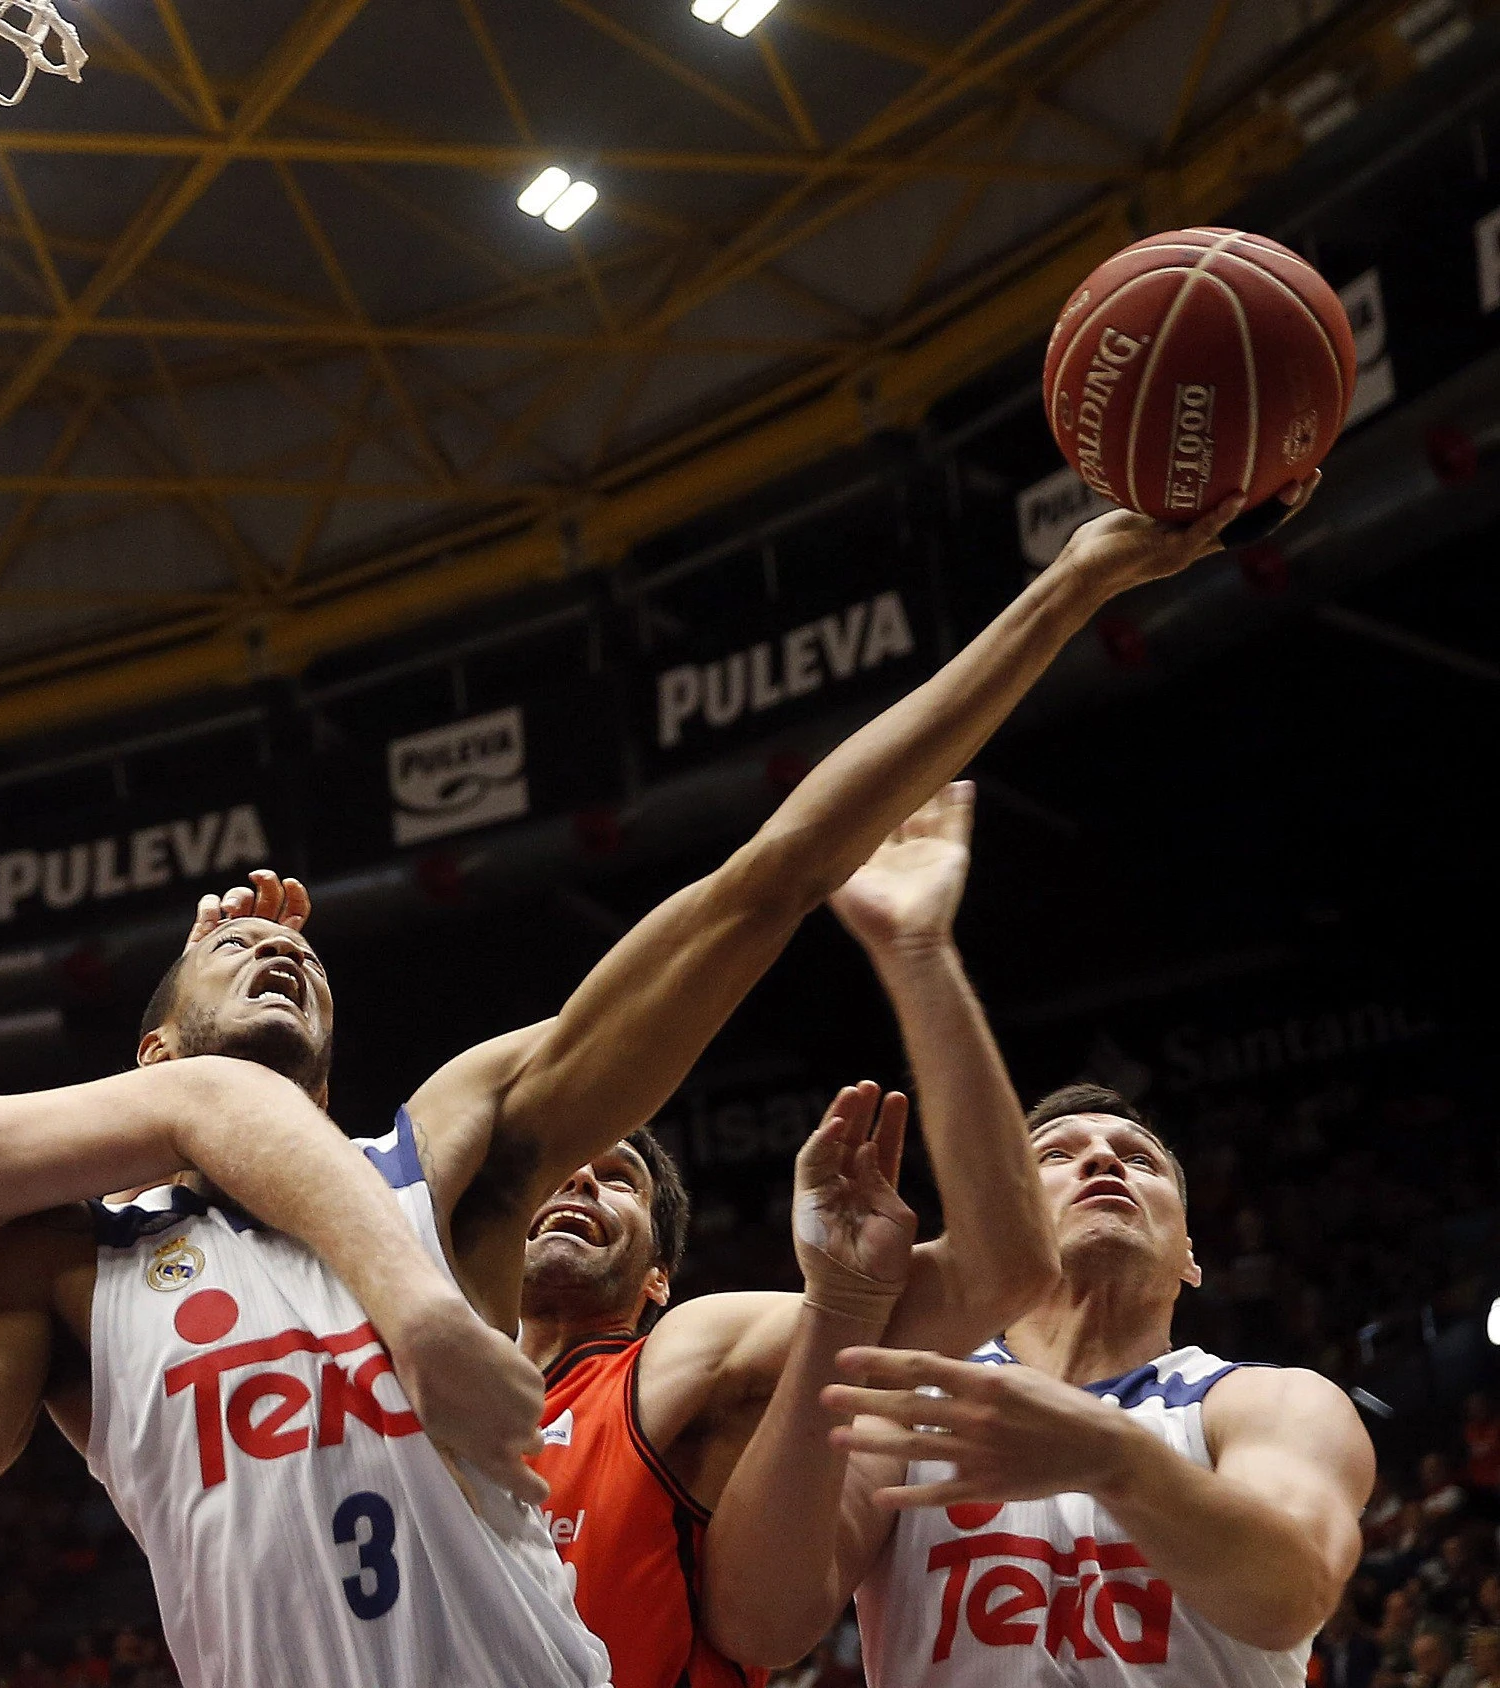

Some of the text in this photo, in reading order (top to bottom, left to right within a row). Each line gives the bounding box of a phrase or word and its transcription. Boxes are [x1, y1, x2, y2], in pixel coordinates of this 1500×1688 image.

[656, 590, 916, 749] PULEVA
[332, 1492, 400, 1621] 3
[927, 1532, 1173, 1665] Teka
